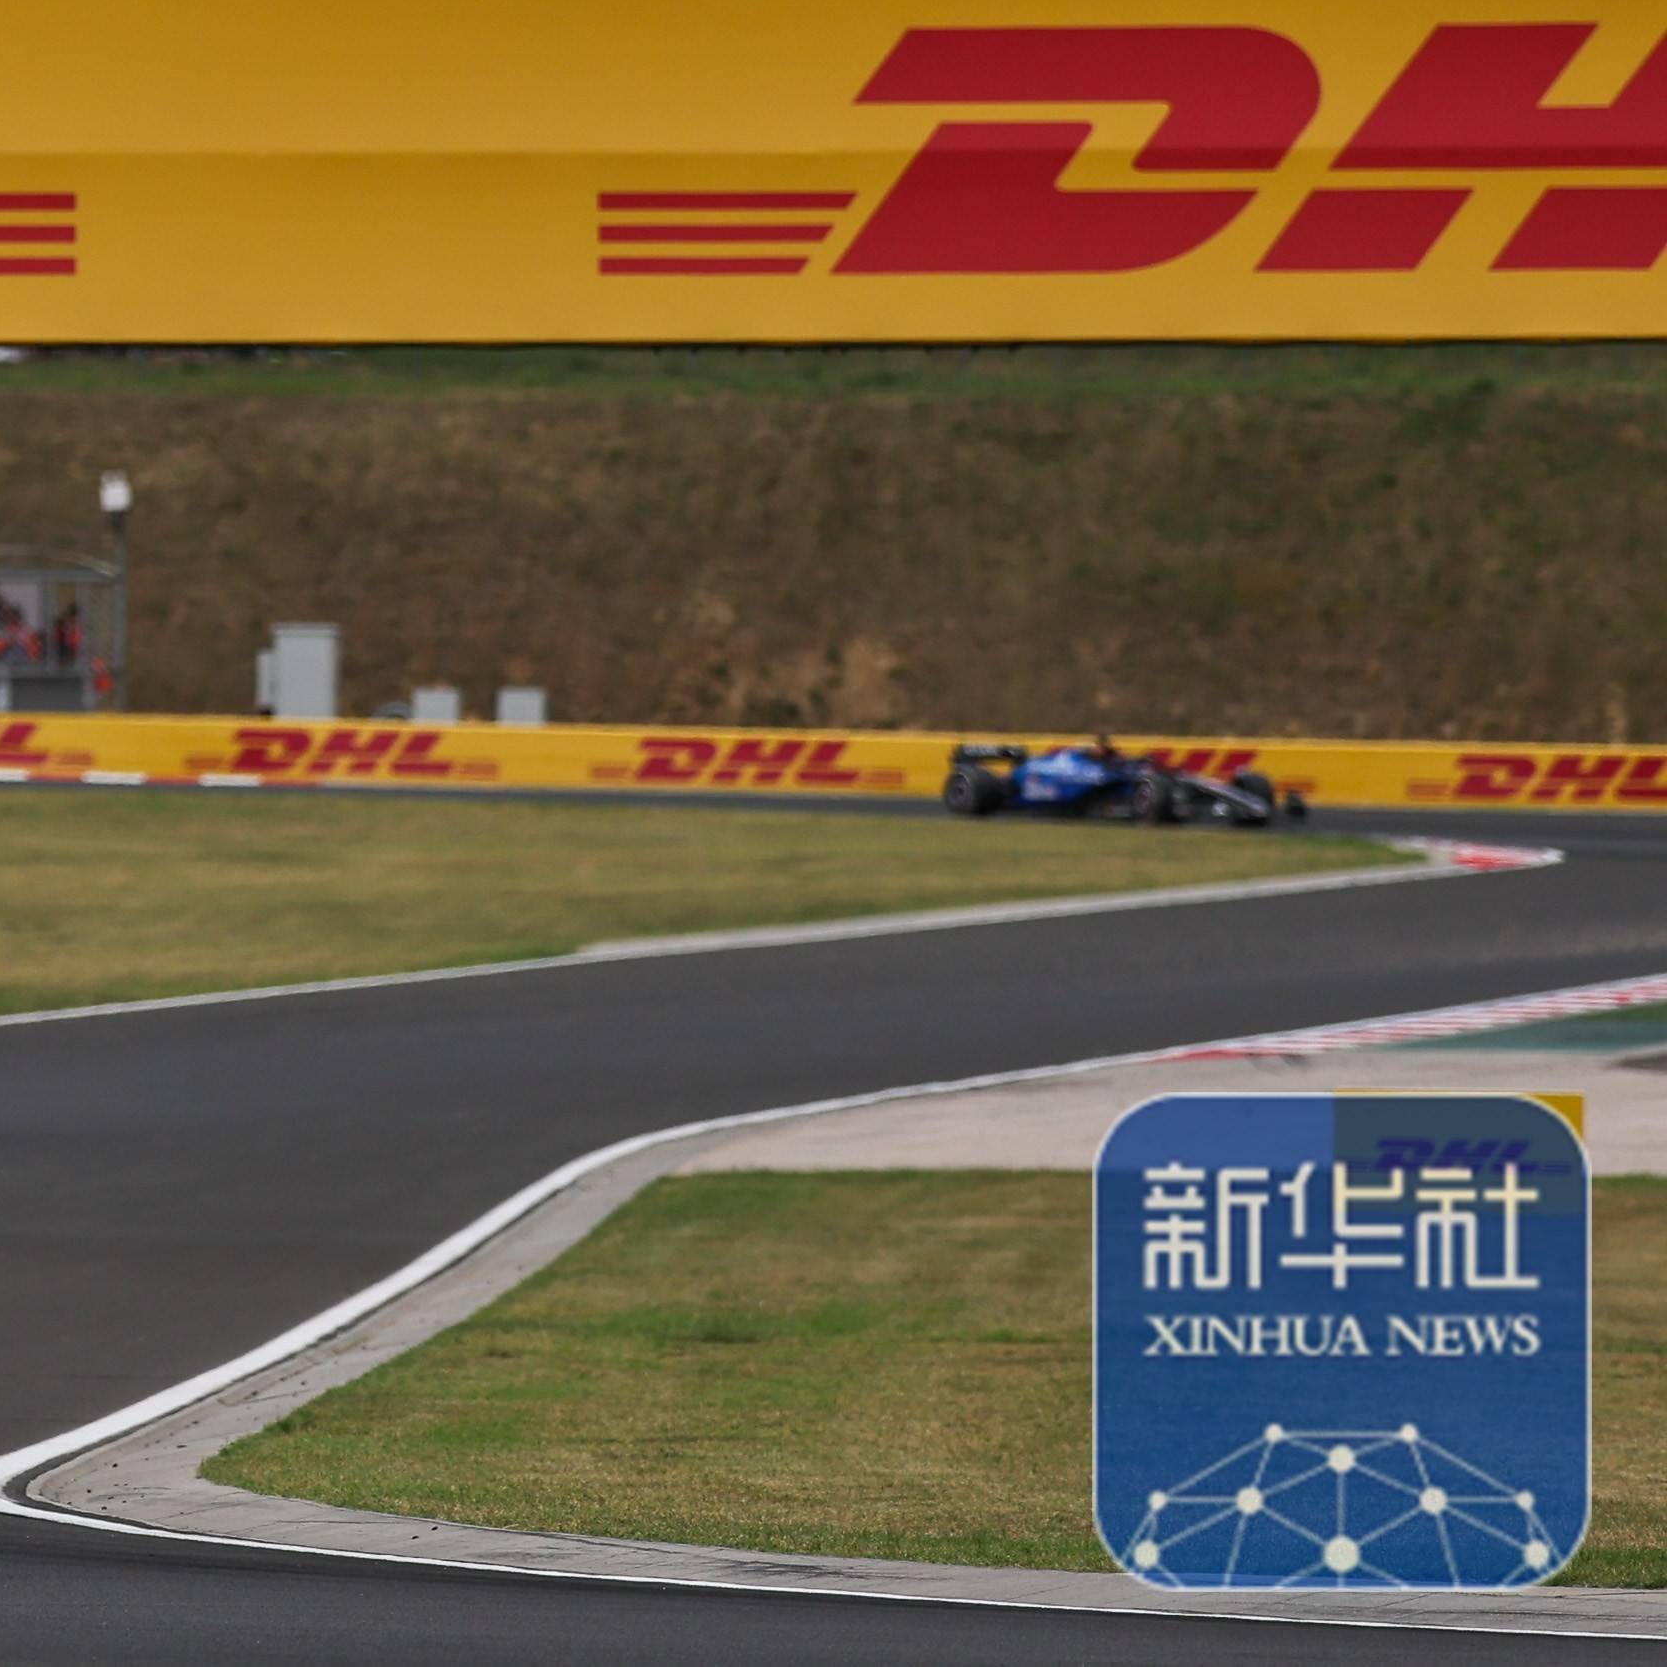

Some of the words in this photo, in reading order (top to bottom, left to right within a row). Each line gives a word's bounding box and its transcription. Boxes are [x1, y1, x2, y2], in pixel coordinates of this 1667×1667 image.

[828, 22, 1667, 275] DH
[230, 727, 453, 774] DHL
[635, 737, 861, 785] DHL
[1454, 754, 1667, 801] DHL
